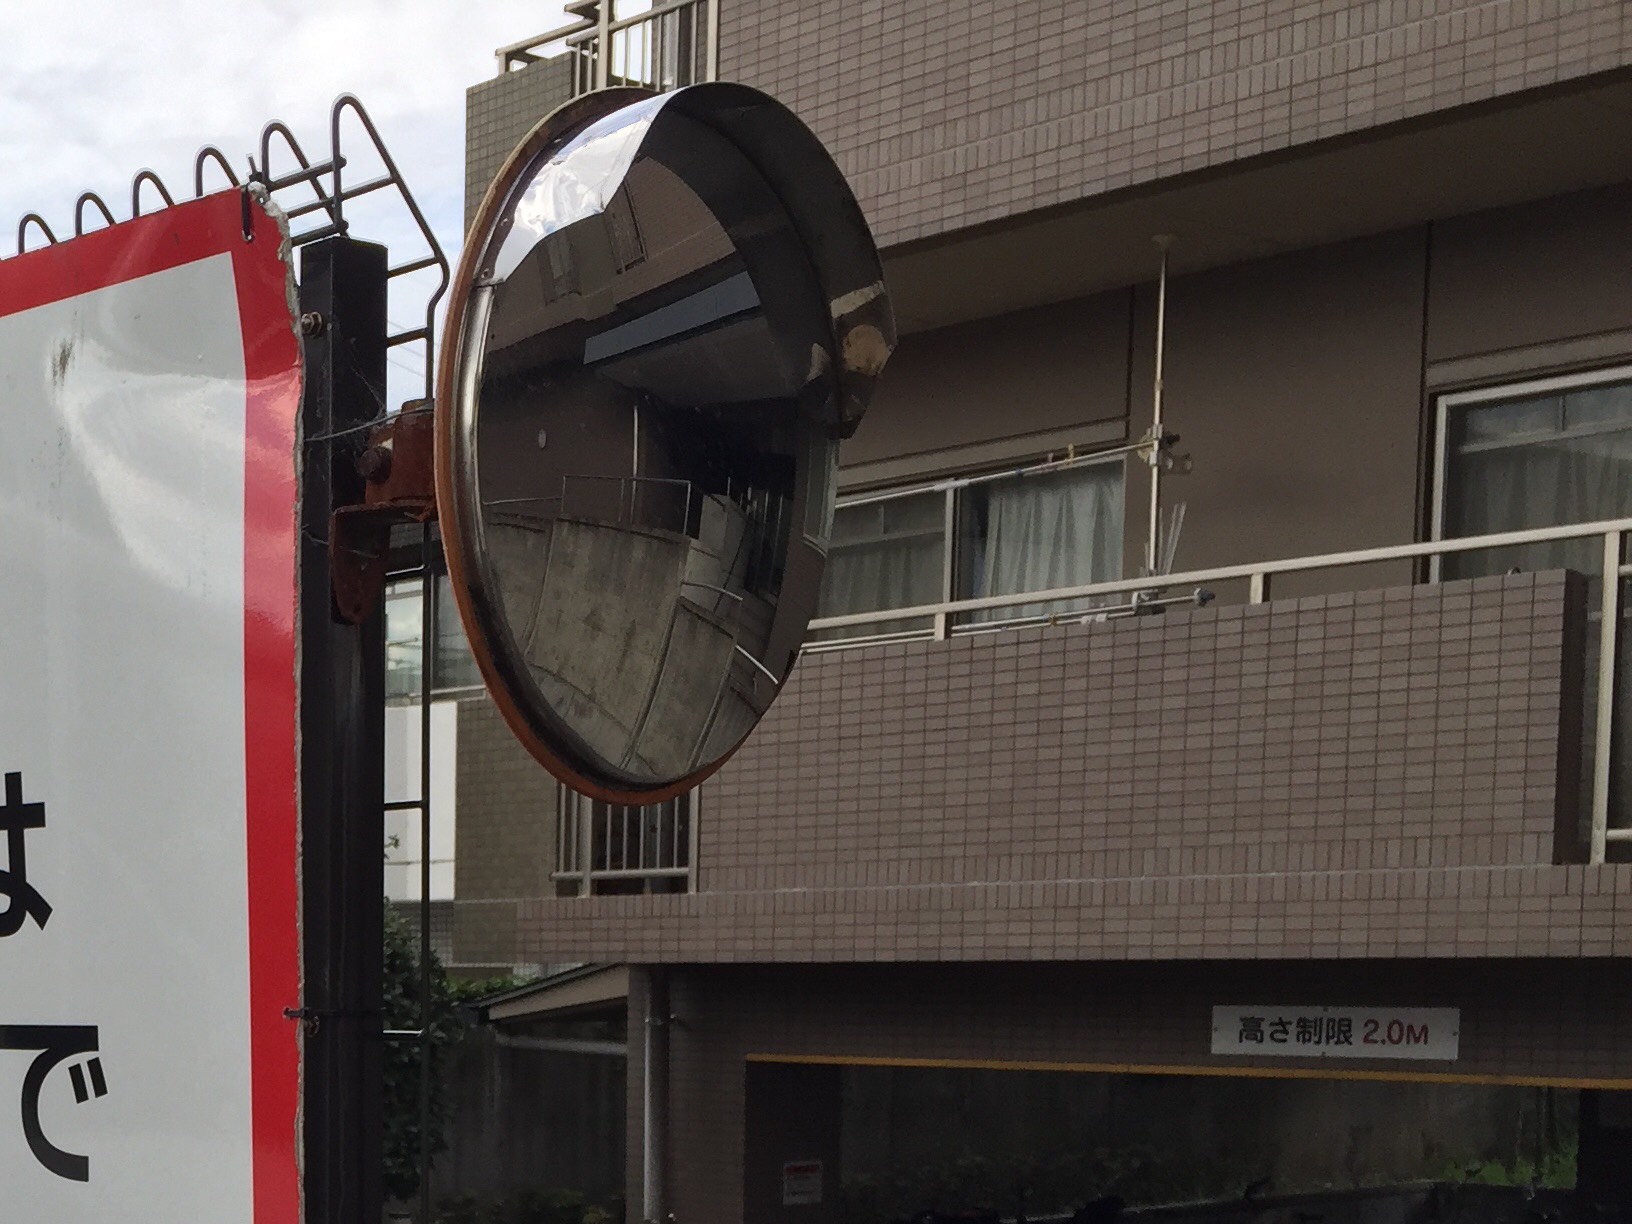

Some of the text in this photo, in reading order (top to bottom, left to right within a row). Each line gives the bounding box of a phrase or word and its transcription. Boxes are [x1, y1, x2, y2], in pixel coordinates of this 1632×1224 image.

[1238, 1015, 1430, 1046] 高さ制限 2.0M
